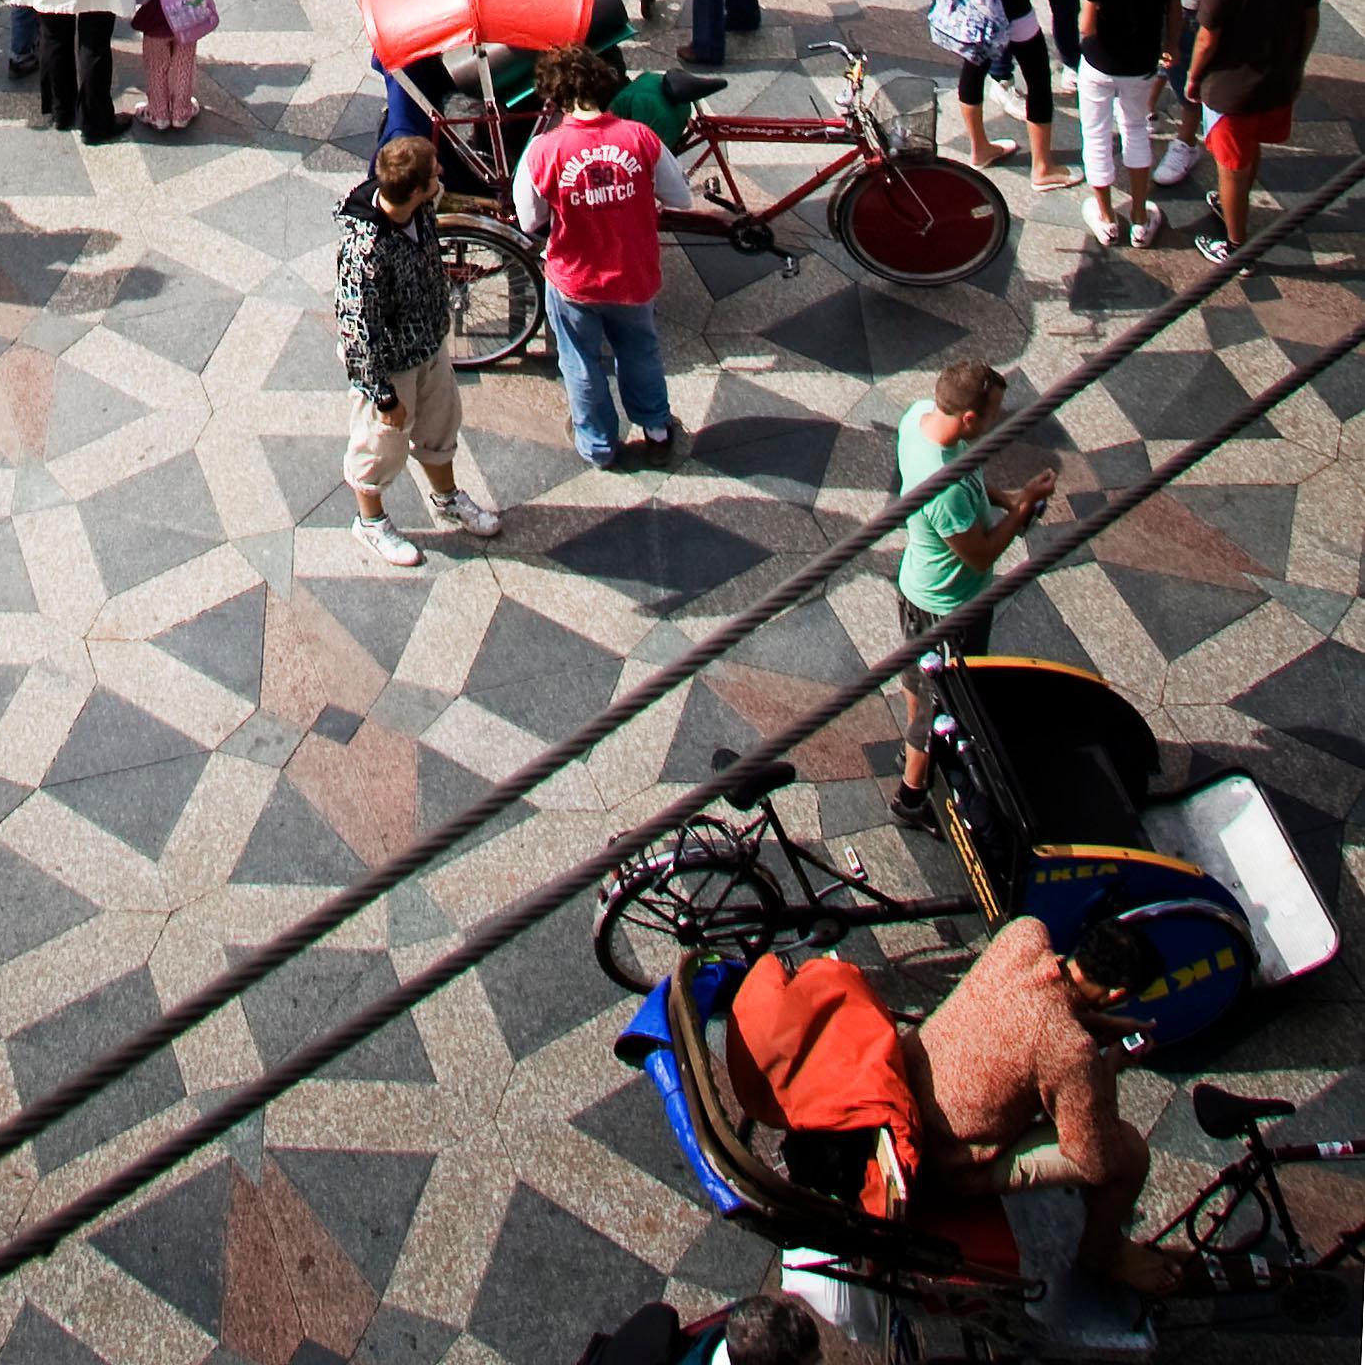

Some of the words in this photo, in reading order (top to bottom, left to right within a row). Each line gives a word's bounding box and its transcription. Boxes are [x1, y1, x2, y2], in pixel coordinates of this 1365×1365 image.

[558, 148, 594, 189] TOOLS
[600, 144, 643, 178] TRADE
[570, 185, 615, 206] G-UNIT
[1036, 863, 1119, 884] IKEA
